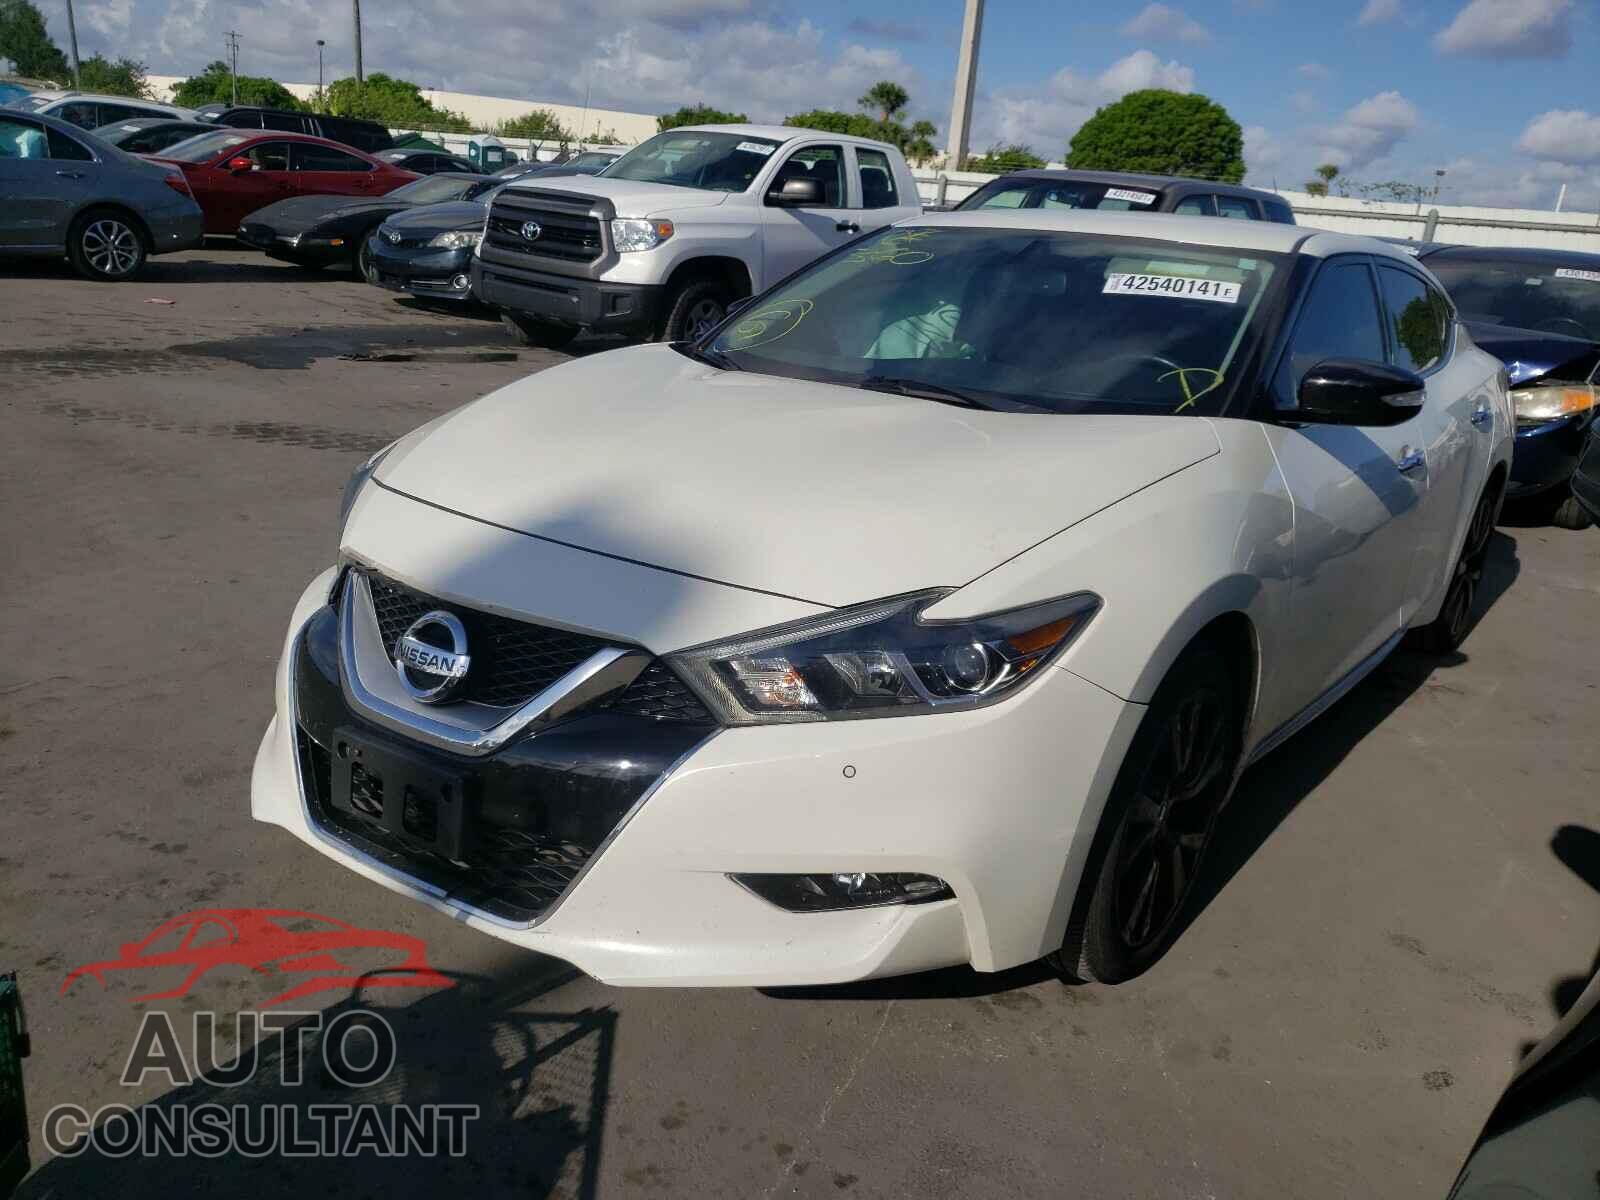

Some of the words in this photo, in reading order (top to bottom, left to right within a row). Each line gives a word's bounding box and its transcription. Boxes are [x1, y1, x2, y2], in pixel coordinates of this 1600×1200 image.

[1122, 275, 1221, 297] 42540141
[1224, 288, 1233, 296] F
[399, 642, 457, 672] NISSAN
